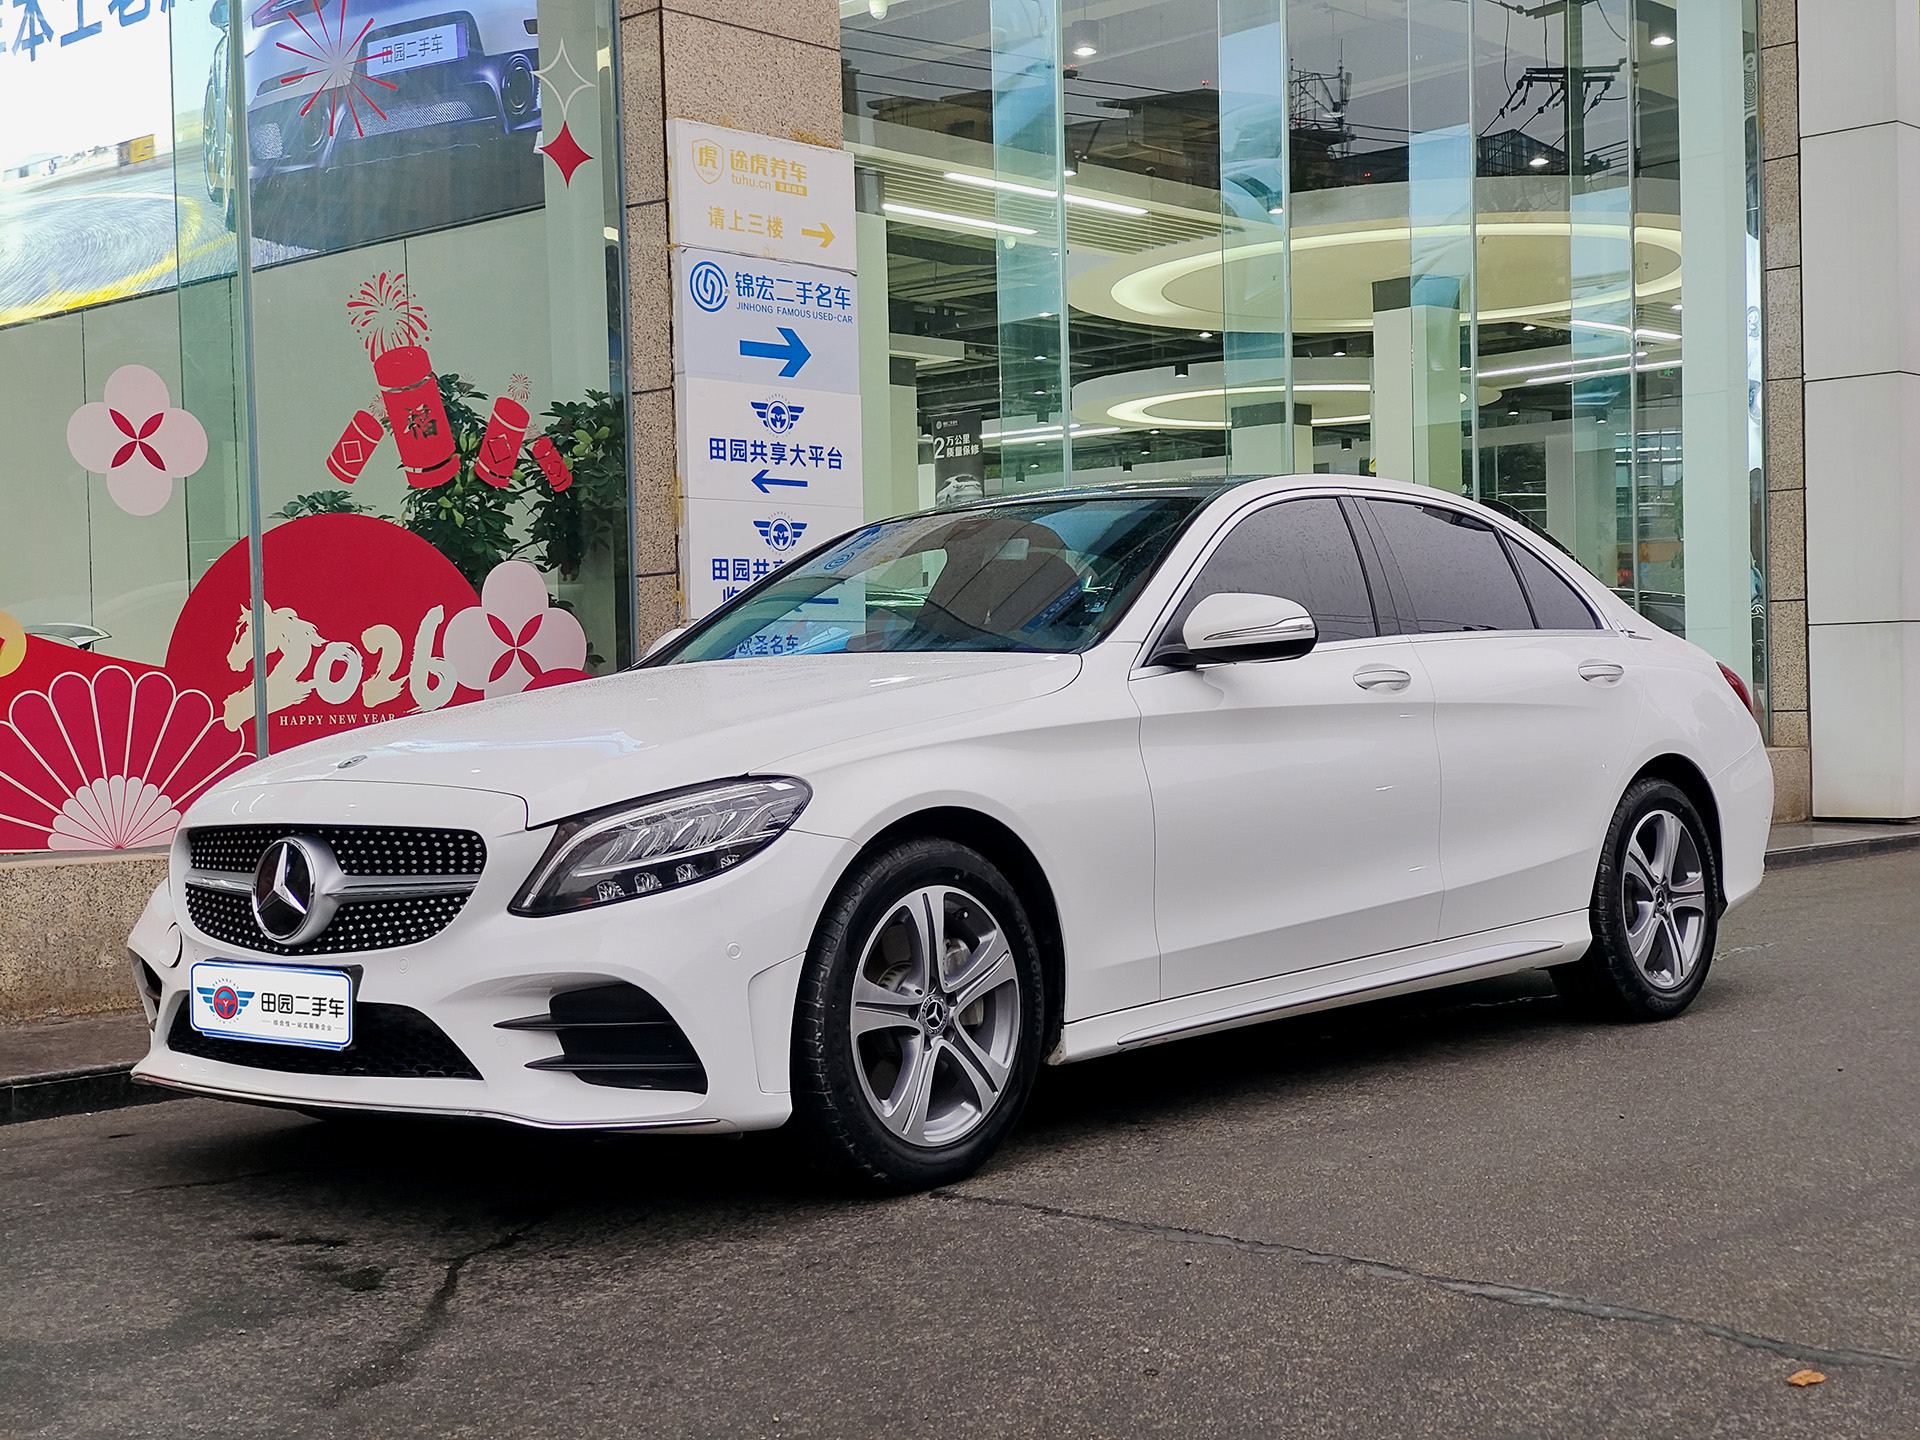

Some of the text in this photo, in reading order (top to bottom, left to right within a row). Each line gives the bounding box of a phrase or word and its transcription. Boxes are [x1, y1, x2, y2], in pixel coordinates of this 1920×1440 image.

[381, 33, 444, 65] 田园二手车
[698, 145, 719, 170] 虎
[729, 148, 808, 183] 途虎养车
[731, 172, 772, 191] tuhu.cn
[707, 205, 784, 239] 请上三楼
[734, 271, 852, 311] 锦宏二手名车
[736, 302, 853, 324] JINHONG FAMOUS USED-CAR
[403, 403, 438, 440] 福
[708, 437, 844, 471] 田园共享大平台
[934, 433, 971, 459] 2 万公里
[946, 444, 980, 458] 质量保修
[223, 598, 458, 732] 2026
[279, 713, 396, 726] HAPPY NEW YEAR
[260, 992, 345, 1019] 田园二手车
